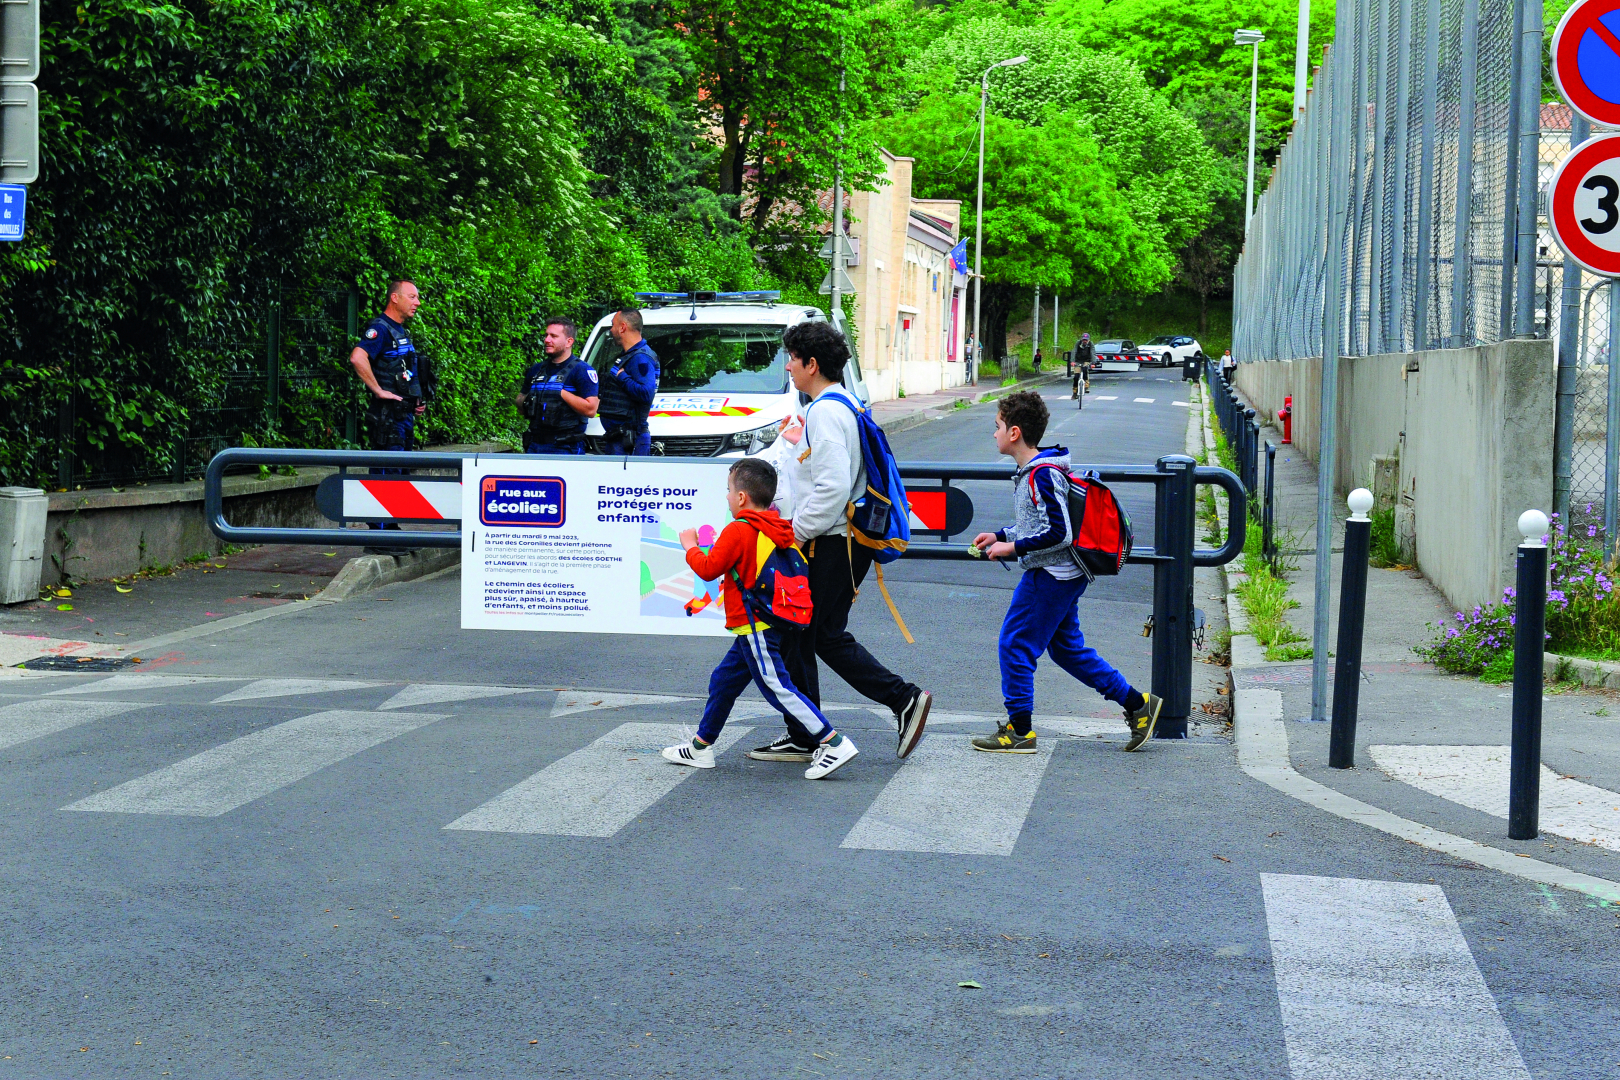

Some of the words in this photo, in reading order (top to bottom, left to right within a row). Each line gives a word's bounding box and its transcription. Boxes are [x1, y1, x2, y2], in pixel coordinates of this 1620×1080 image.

[4, 193, 12, 203] Rue
[1580, 174, 1619, 234] 3
[499, 488, 522, 498] rue
[523, 490, 546, 498] aux
[598, 485, 660, 498] Engagés
[662, 487, 698, 498] pour
[487, 500, 558, 514] écoliers
[598, 499, 663, 511] protéger
[598, 513, 658, 523] enfants.
[998, 736, 1012, 746] N
